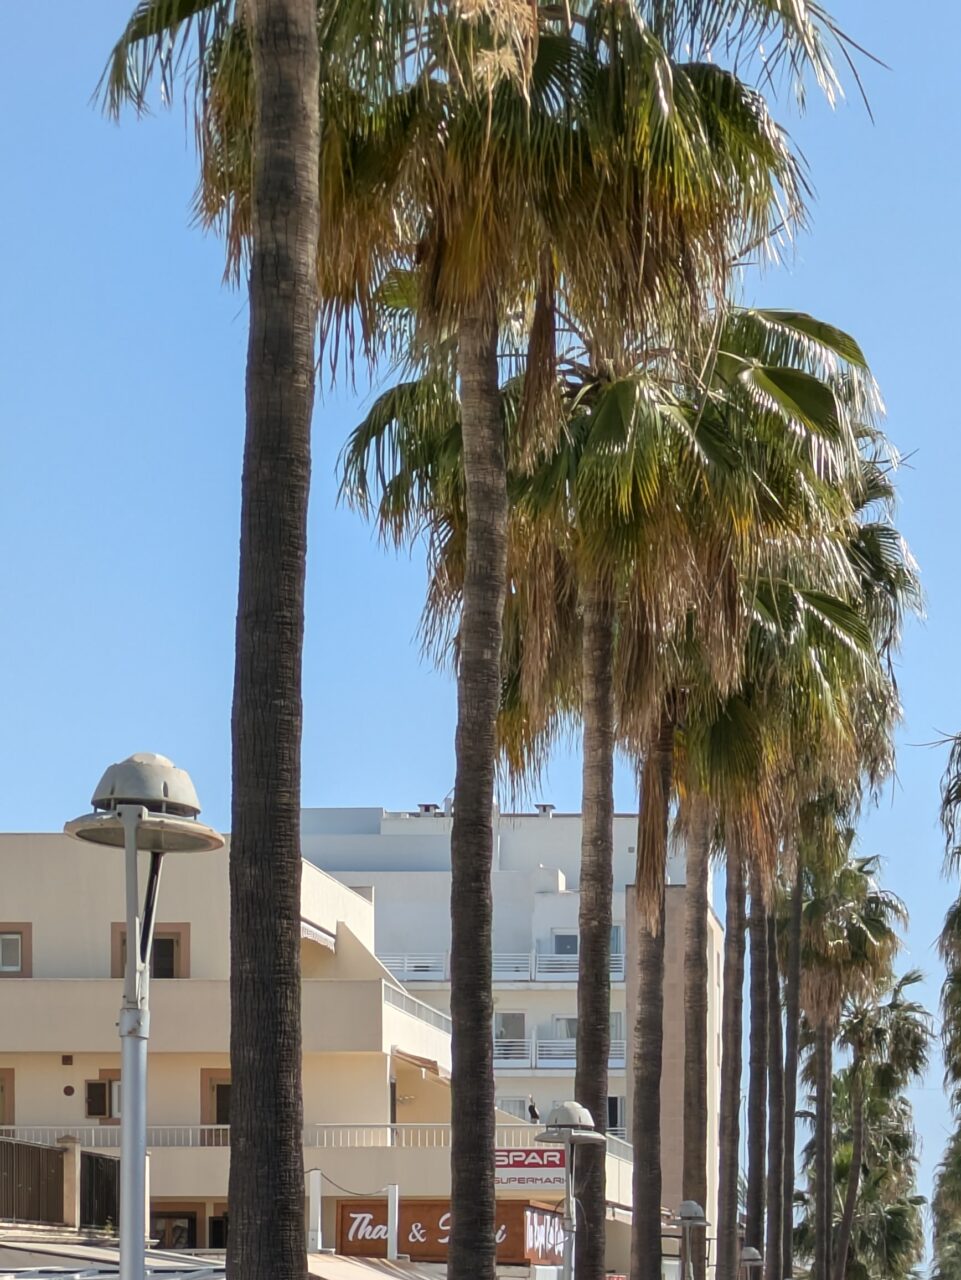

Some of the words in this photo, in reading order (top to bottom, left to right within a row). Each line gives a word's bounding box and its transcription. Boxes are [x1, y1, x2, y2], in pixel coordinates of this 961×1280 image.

[495, 1151, 560, 1165] SPAR
[348, 1213, 388, 1242] Tha
[408, 1222, 426, 1242] &
